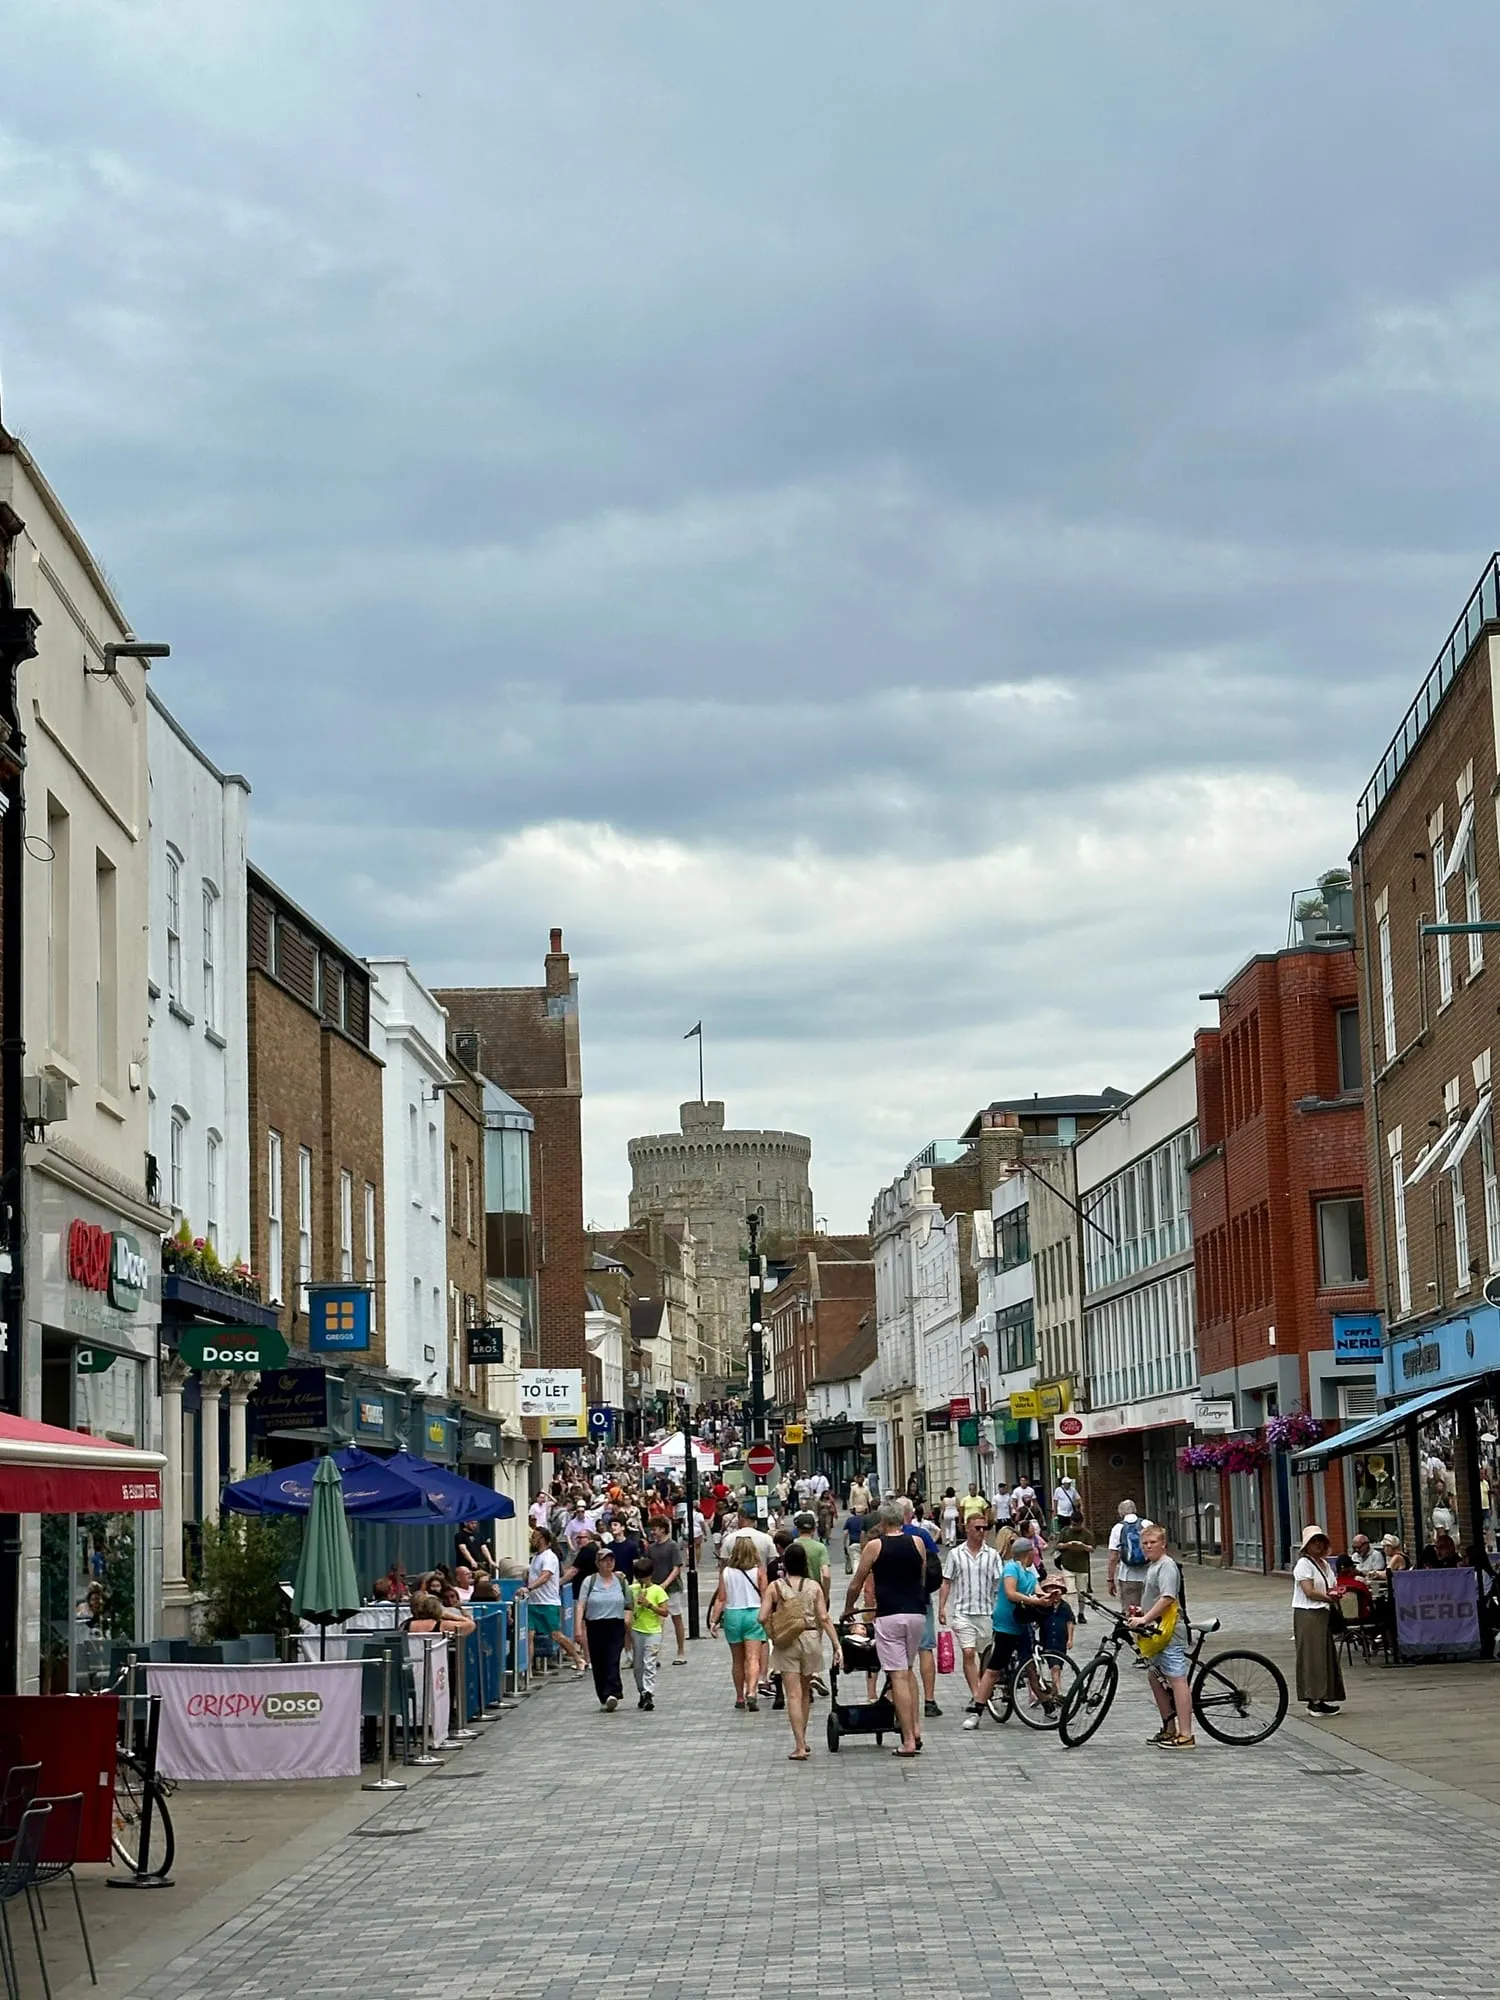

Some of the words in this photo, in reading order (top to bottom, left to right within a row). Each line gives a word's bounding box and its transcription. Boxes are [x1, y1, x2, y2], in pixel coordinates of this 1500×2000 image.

[116, 1238, 148, 1289] Dosa
[325, 1333, 354, 1341] GREGGS
[1337, 1338, 1380, 1350] NERO
[203, 1347, 259, 1362] Dosa
[522, 1385, 541, 1397] TO
[545, 1385, 569, 1397] LET
[1400, 1601, 1474, 1621] NERO
[187, 1694, 264, 1716] CRISPY
[267, 1698, 321, 1712] Dosa
